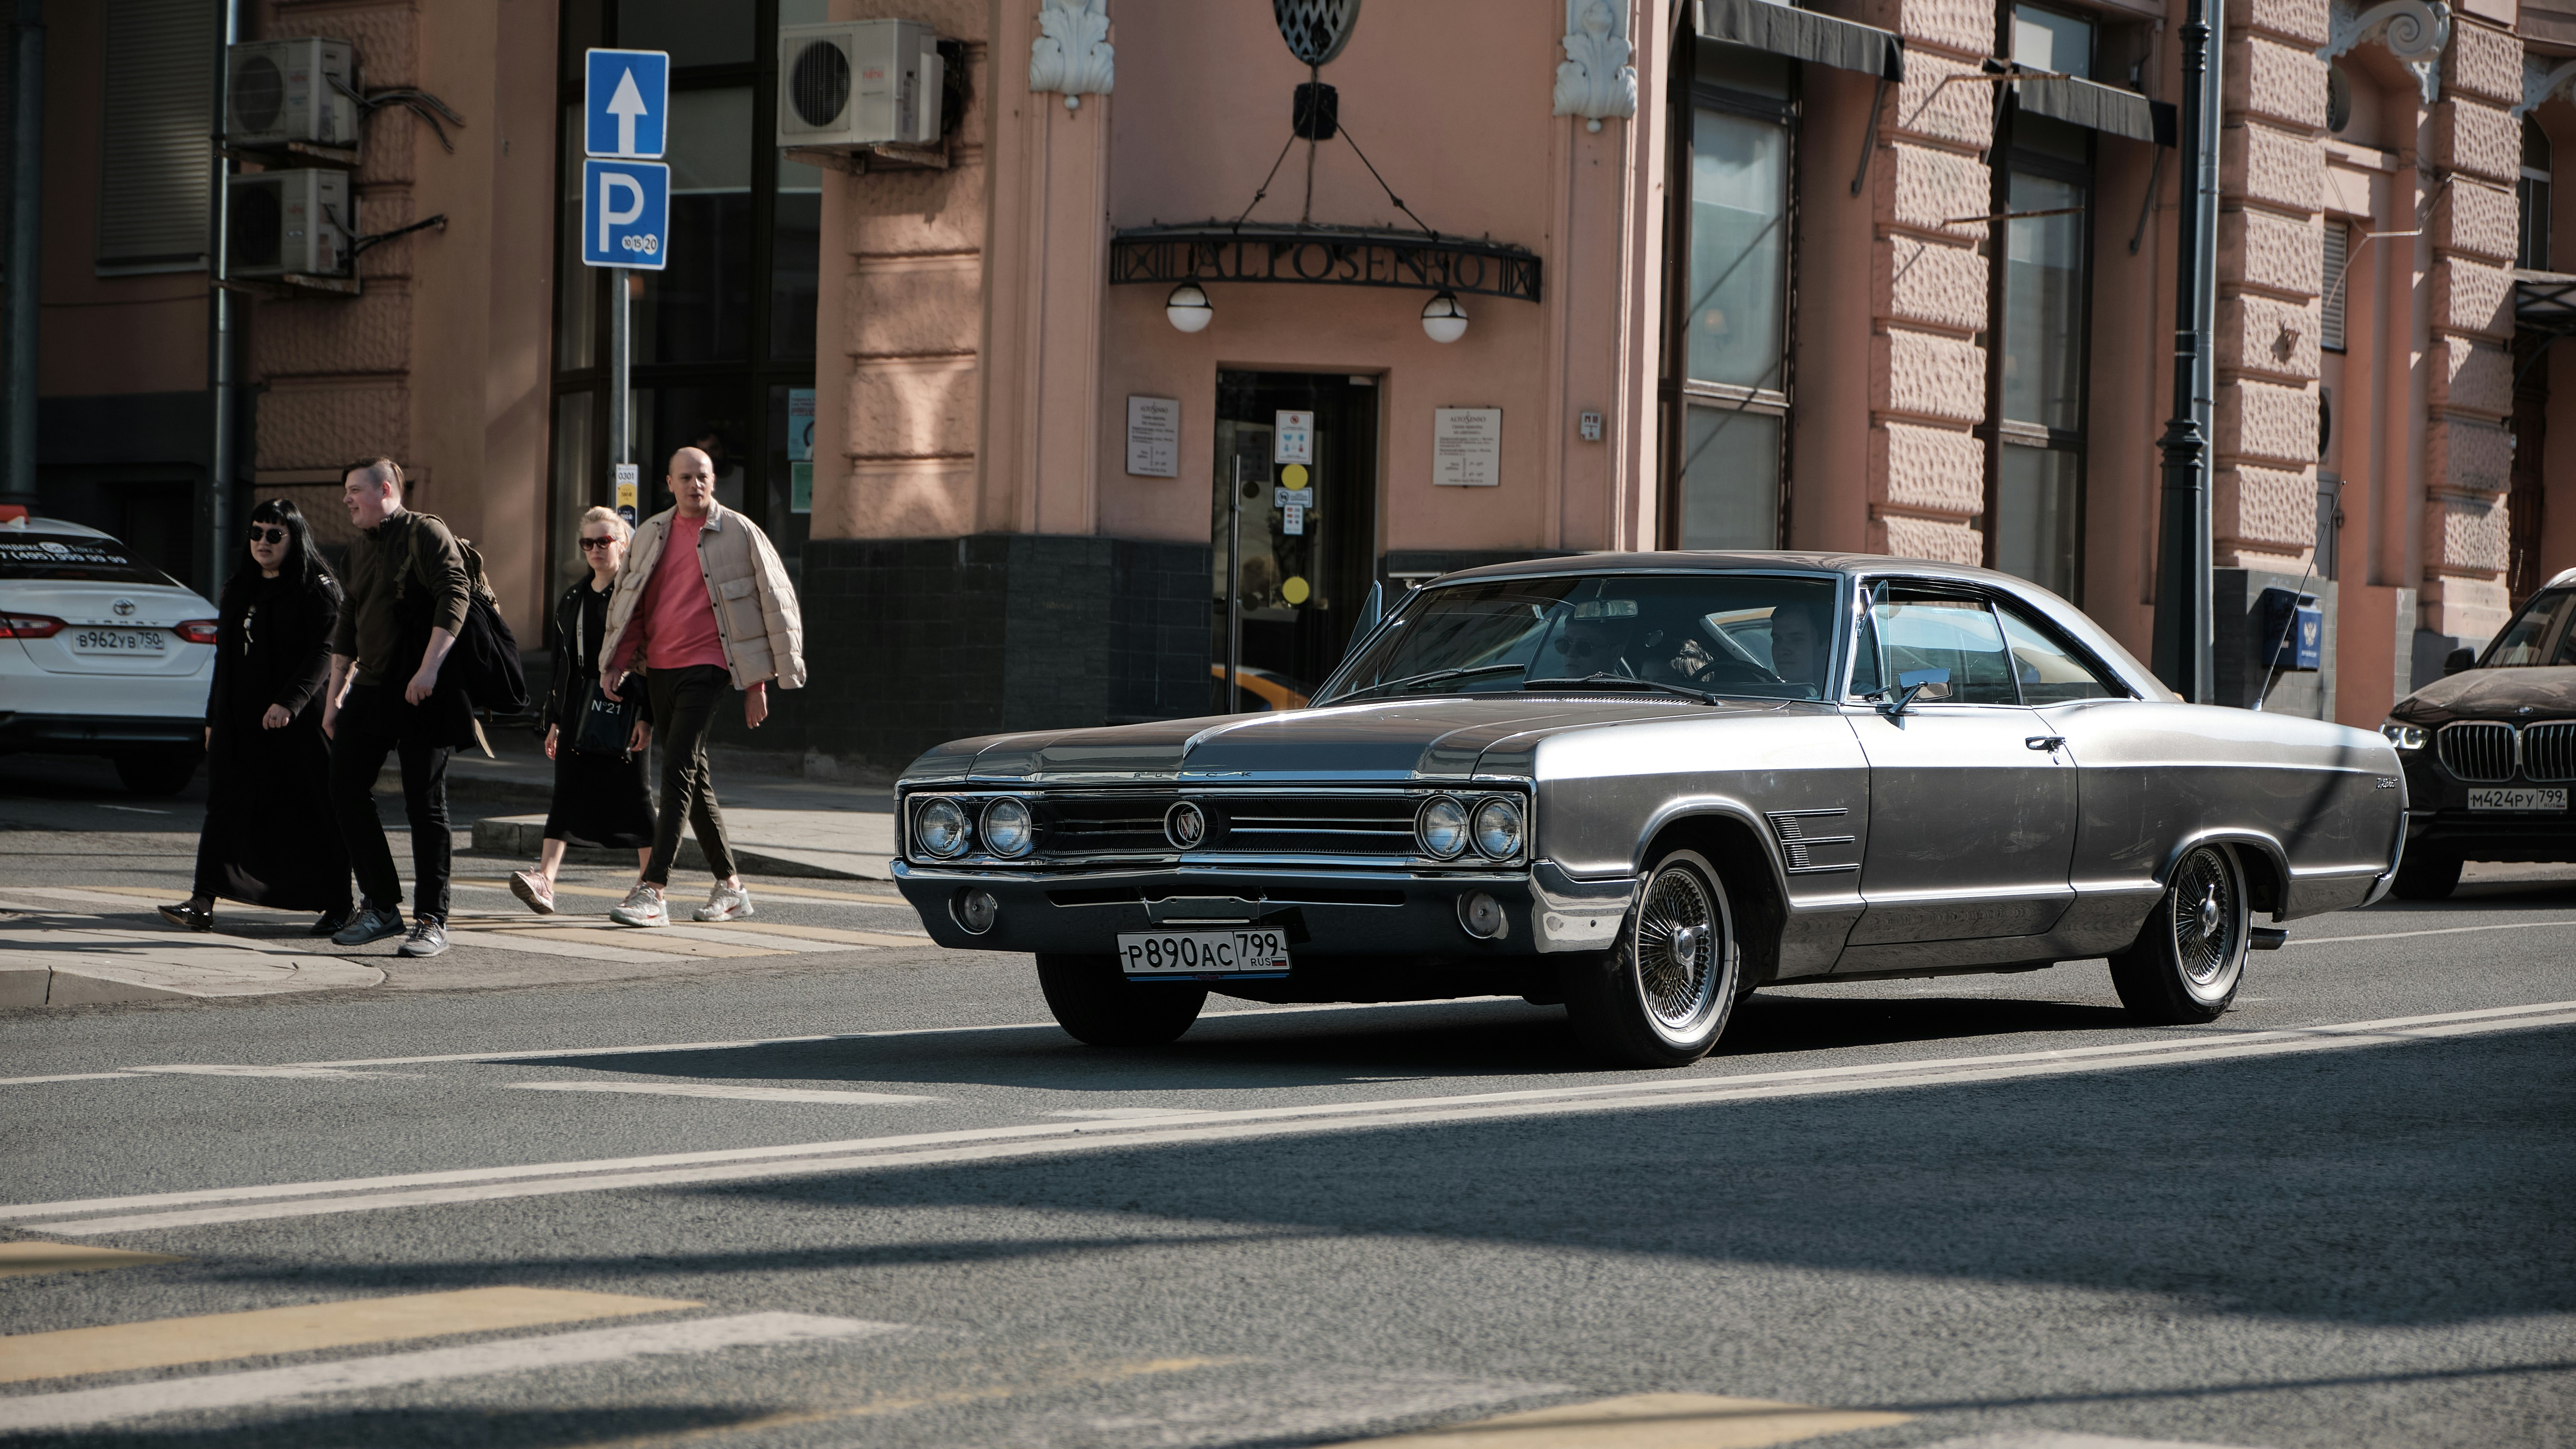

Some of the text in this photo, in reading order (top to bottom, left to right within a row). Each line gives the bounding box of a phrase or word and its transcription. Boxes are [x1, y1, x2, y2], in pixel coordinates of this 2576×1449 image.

[599, 172, 644, 253] P
[634, 239, 642, 248] 15
[645, 238, 657, 250] 20
[618, 472, 634, 480] 0301
[54, 553, 86, 562] 999
[85, 554, 107, 563] 99
[107, 555, 128, 564] 99
[138, 632, 160, 645] 750
[2538, 790, 2563, 803] 799
[1236, 933, 1278, 957] 799
[1250, 958, 1272, 967] RUS
